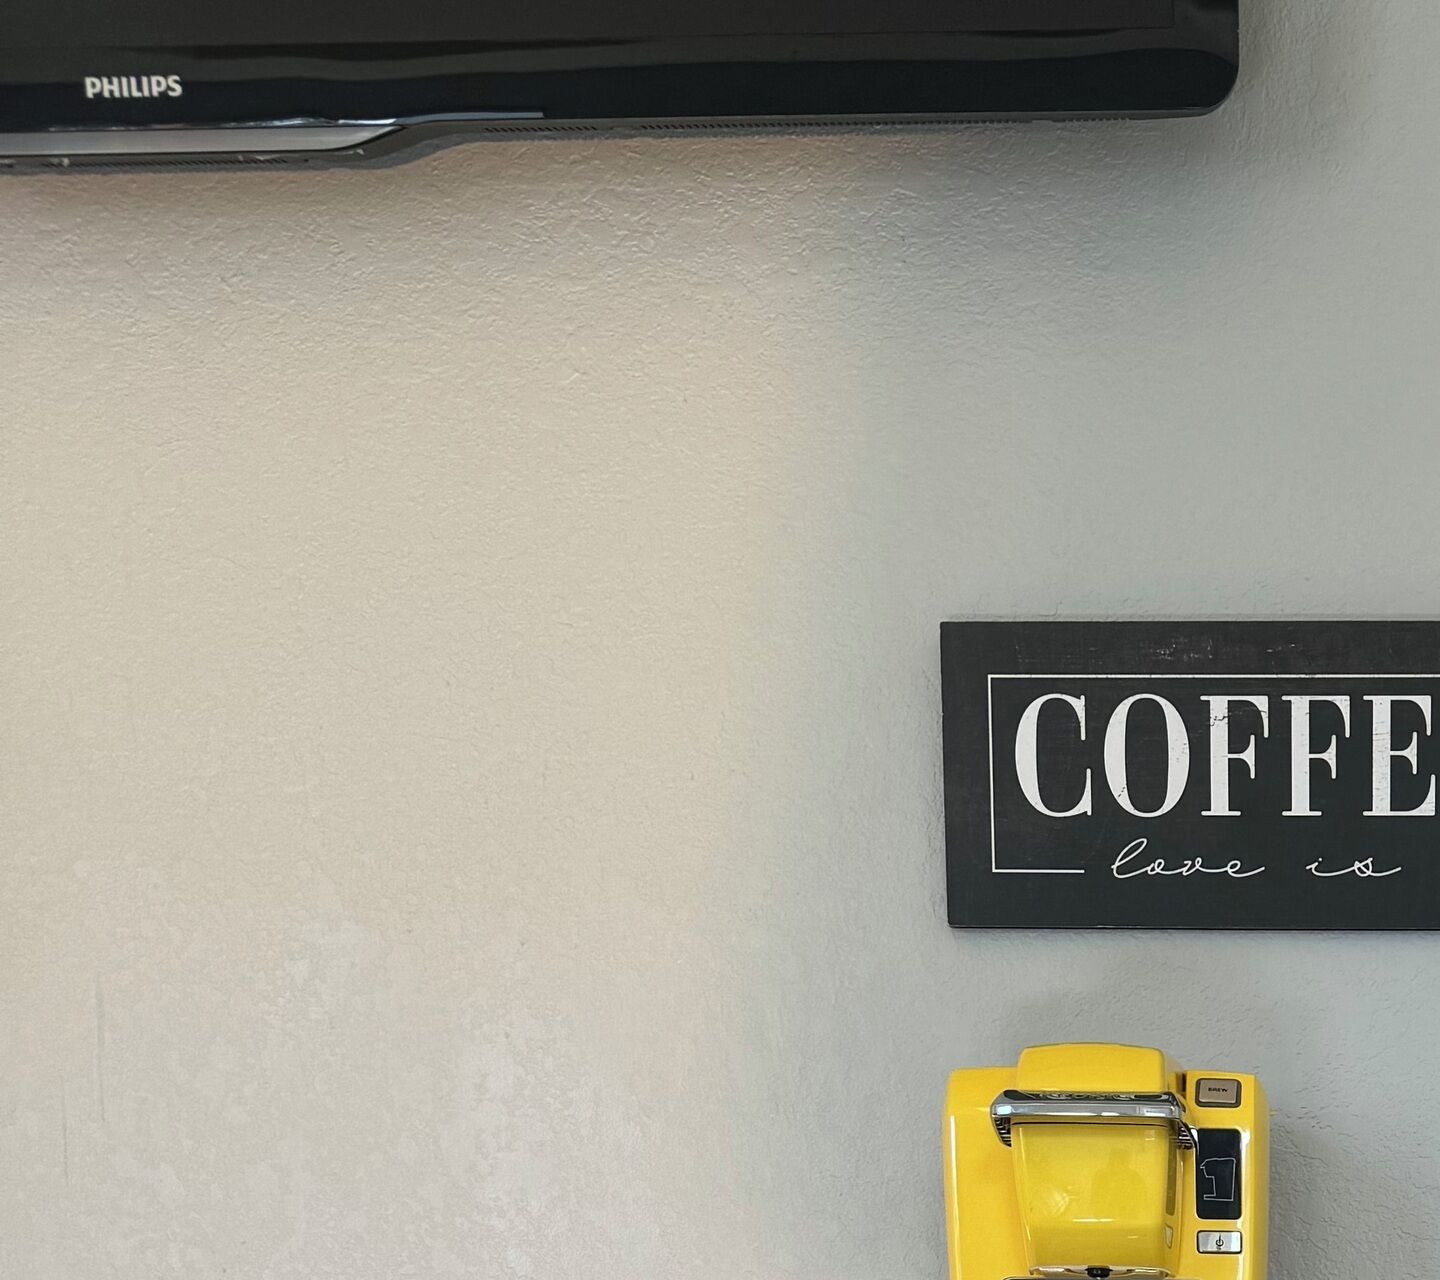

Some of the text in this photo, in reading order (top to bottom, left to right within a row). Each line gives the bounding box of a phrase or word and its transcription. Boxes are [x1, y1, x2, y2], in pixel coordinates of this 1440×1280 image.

[84, 74, 183, 99] PHILIPS
[1111, 836, 1266, 879] love
[1305, 856, 1402, 878] is
